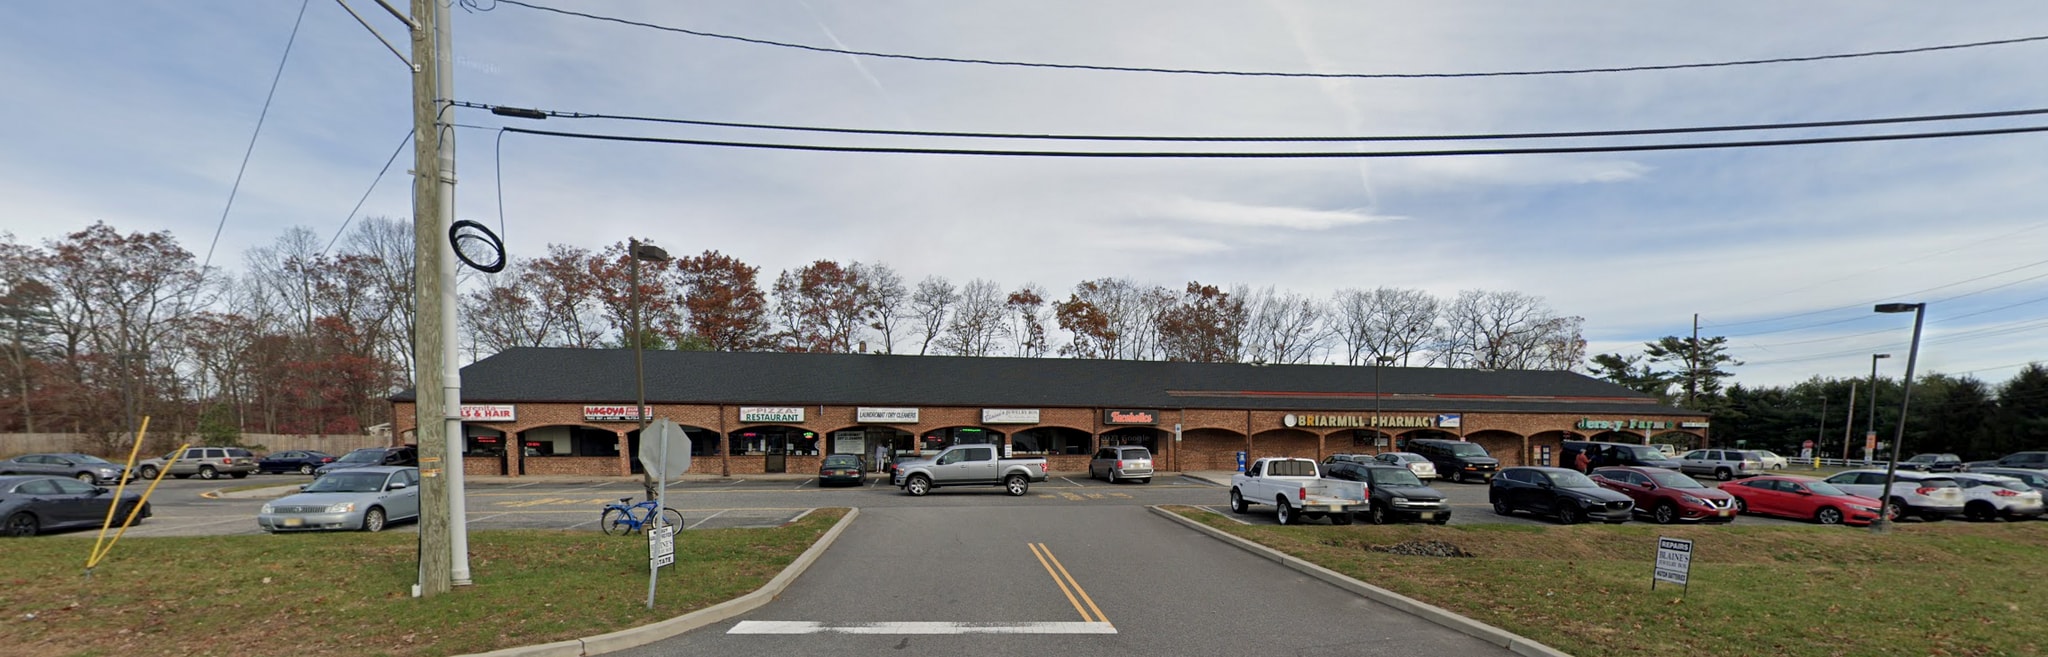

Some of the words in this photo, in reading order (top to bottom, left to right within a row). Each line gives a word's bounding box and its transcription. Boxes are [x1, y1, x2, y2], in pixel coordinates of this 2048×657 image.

[585, 407, 625, 416] NAGOYA
[746, 413, 798, 421] RESTAURANT
[1298, 415, 1365, 427] BRIARMILL
[1371, 415, 1436, 427] PHARMACY
[1577, 418, 1623, 431] Jersey
[1661, 541, 1689, 550] REPAIRS
